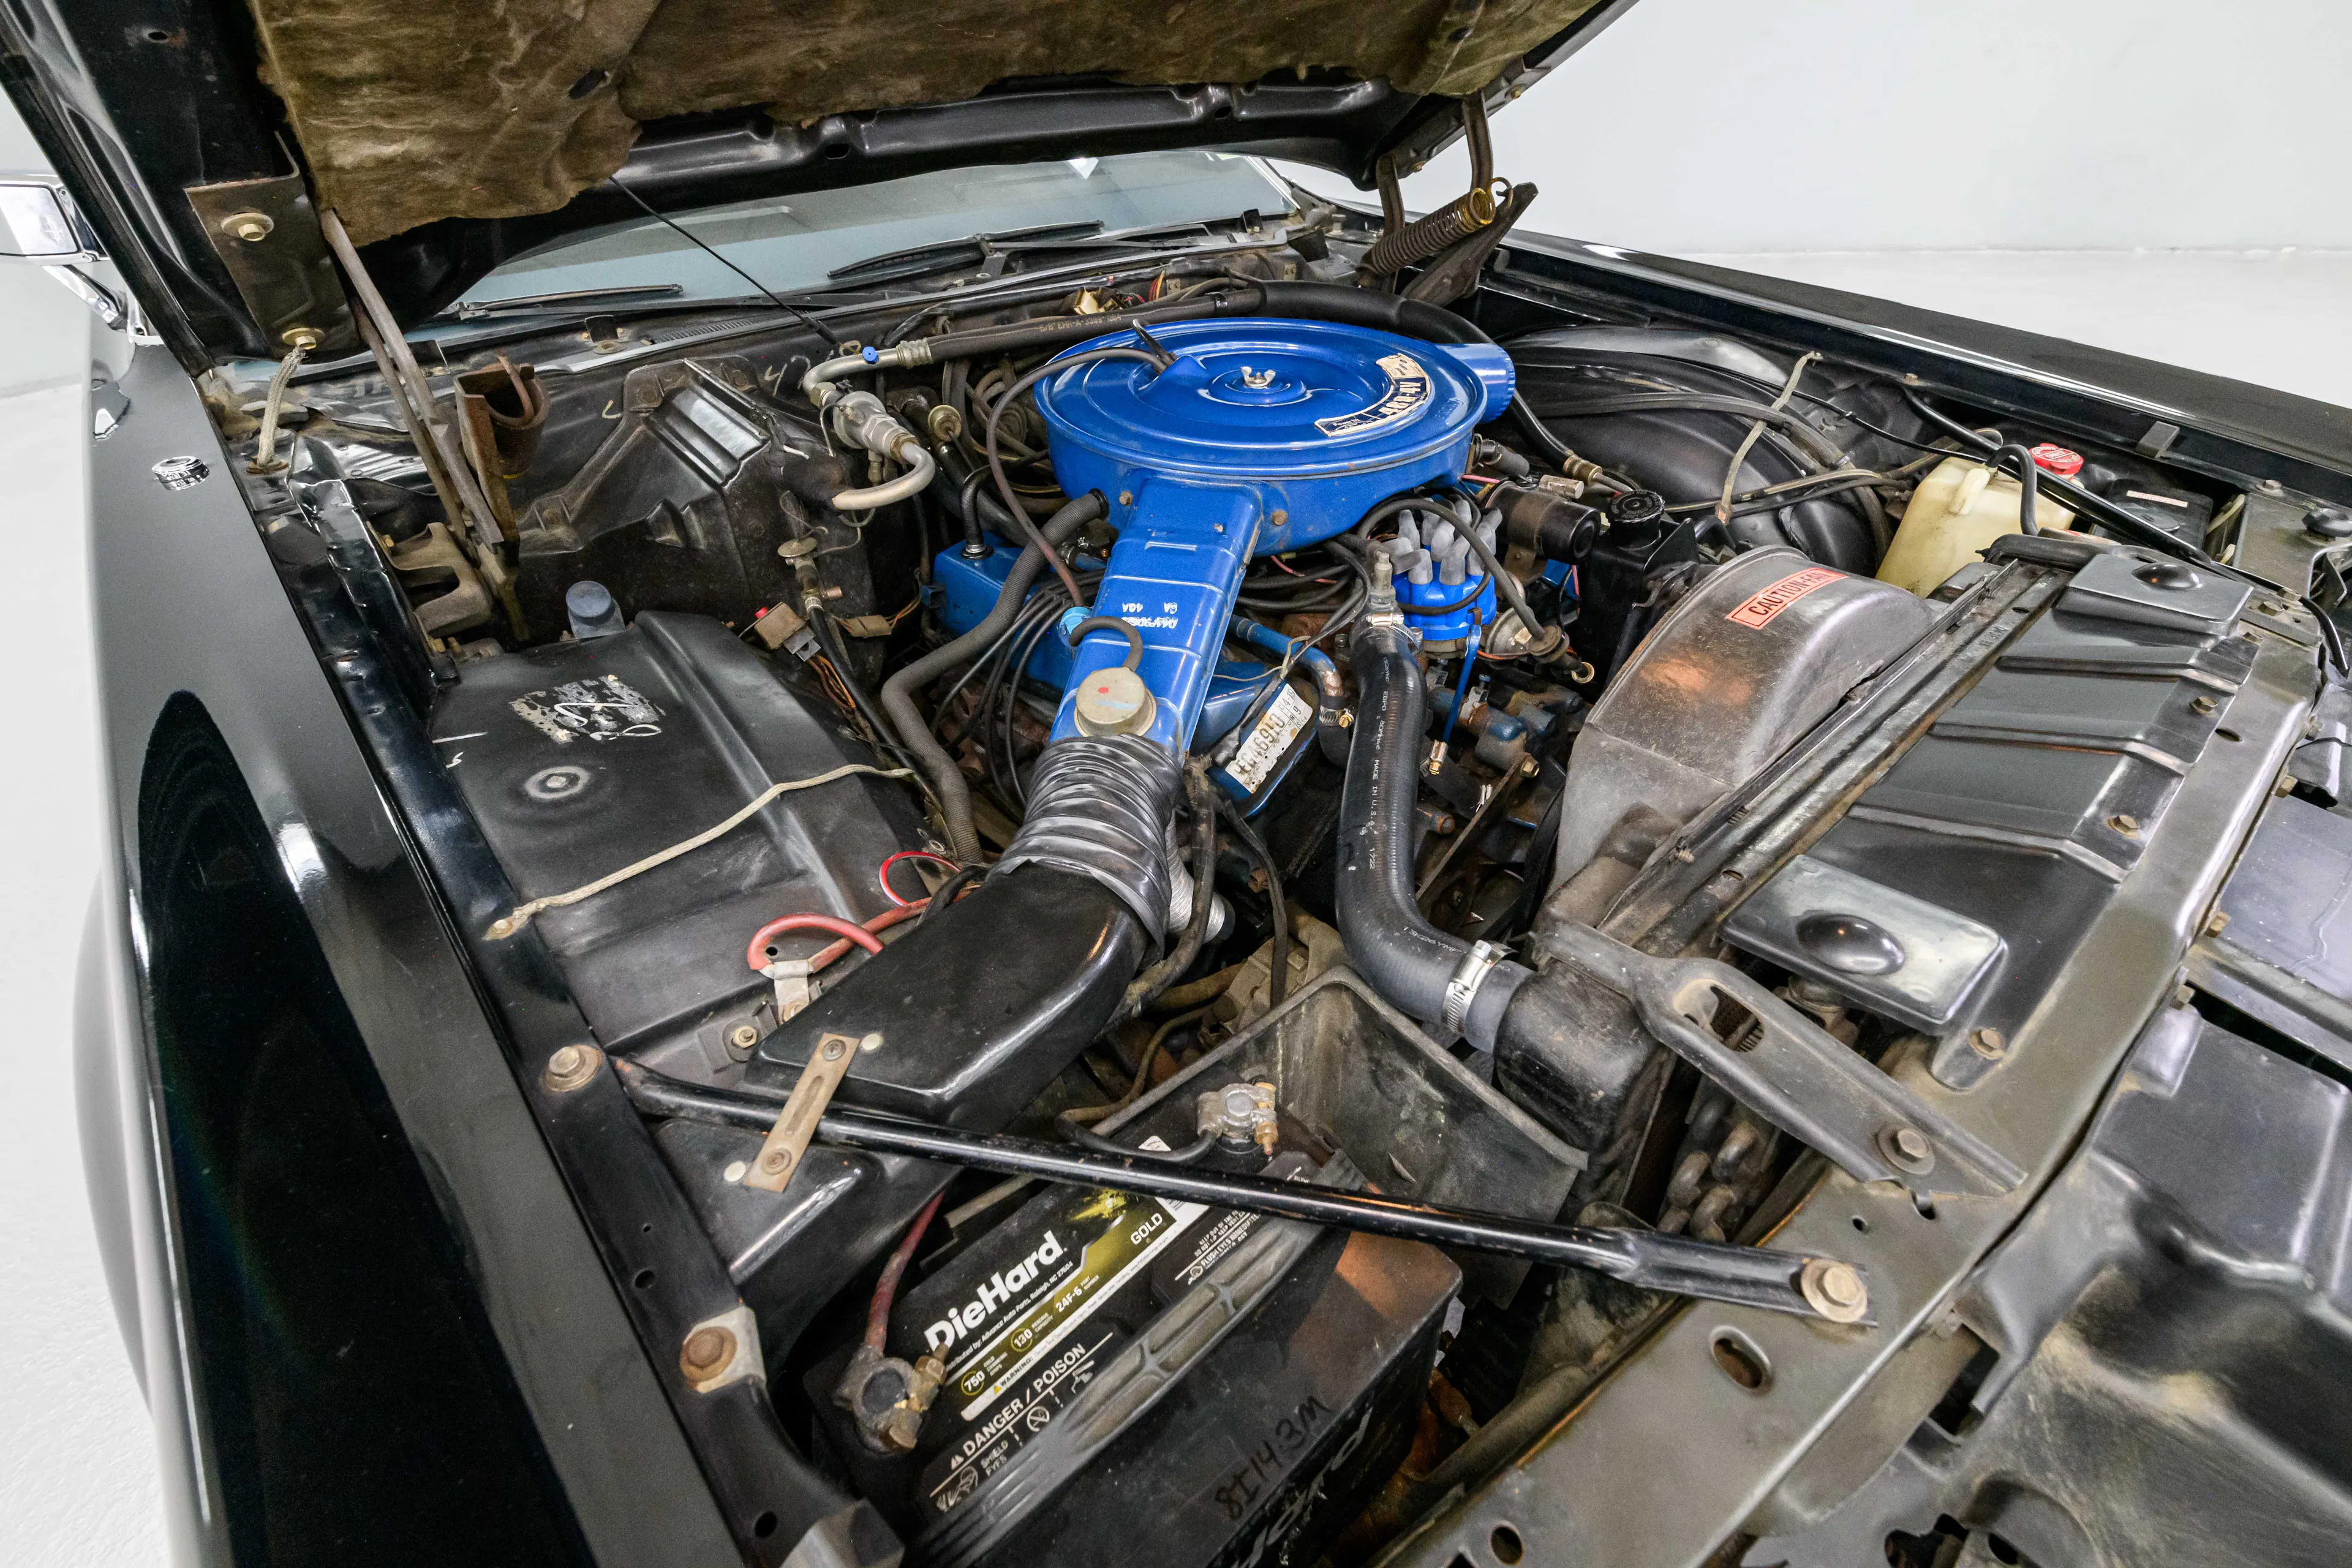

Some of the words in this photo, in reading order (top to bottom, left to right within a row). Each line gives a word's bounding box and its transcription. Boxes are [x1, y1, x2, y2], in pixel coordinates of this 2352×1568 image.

[1372, 786, 1378, 796] IN
[1130, 1212, 1163, 1245] GOLD
[1201, 1250, 1219, 1267] FLUSH
[1218, 1238, 1232, 1253] EYES
[1231, 1213, 1261, 1242] IMMEDIATEL
[924, 1230, 1064, 1352] DieHard
[1055, 1286, 1083, 1313] 24F-6
[946, 1342, 973, 1371] stributed
[982, 1321, 1003, 1342] Advance
[1003, 1310, 1017, 1324] Auto
[1014, 1329, 1033, 1348] 130
[963, 1371, 986, 1392] 750
[963, 1398, 1024, 1457] DANGER
[1033, 1343, 1086, 1393] POISON
